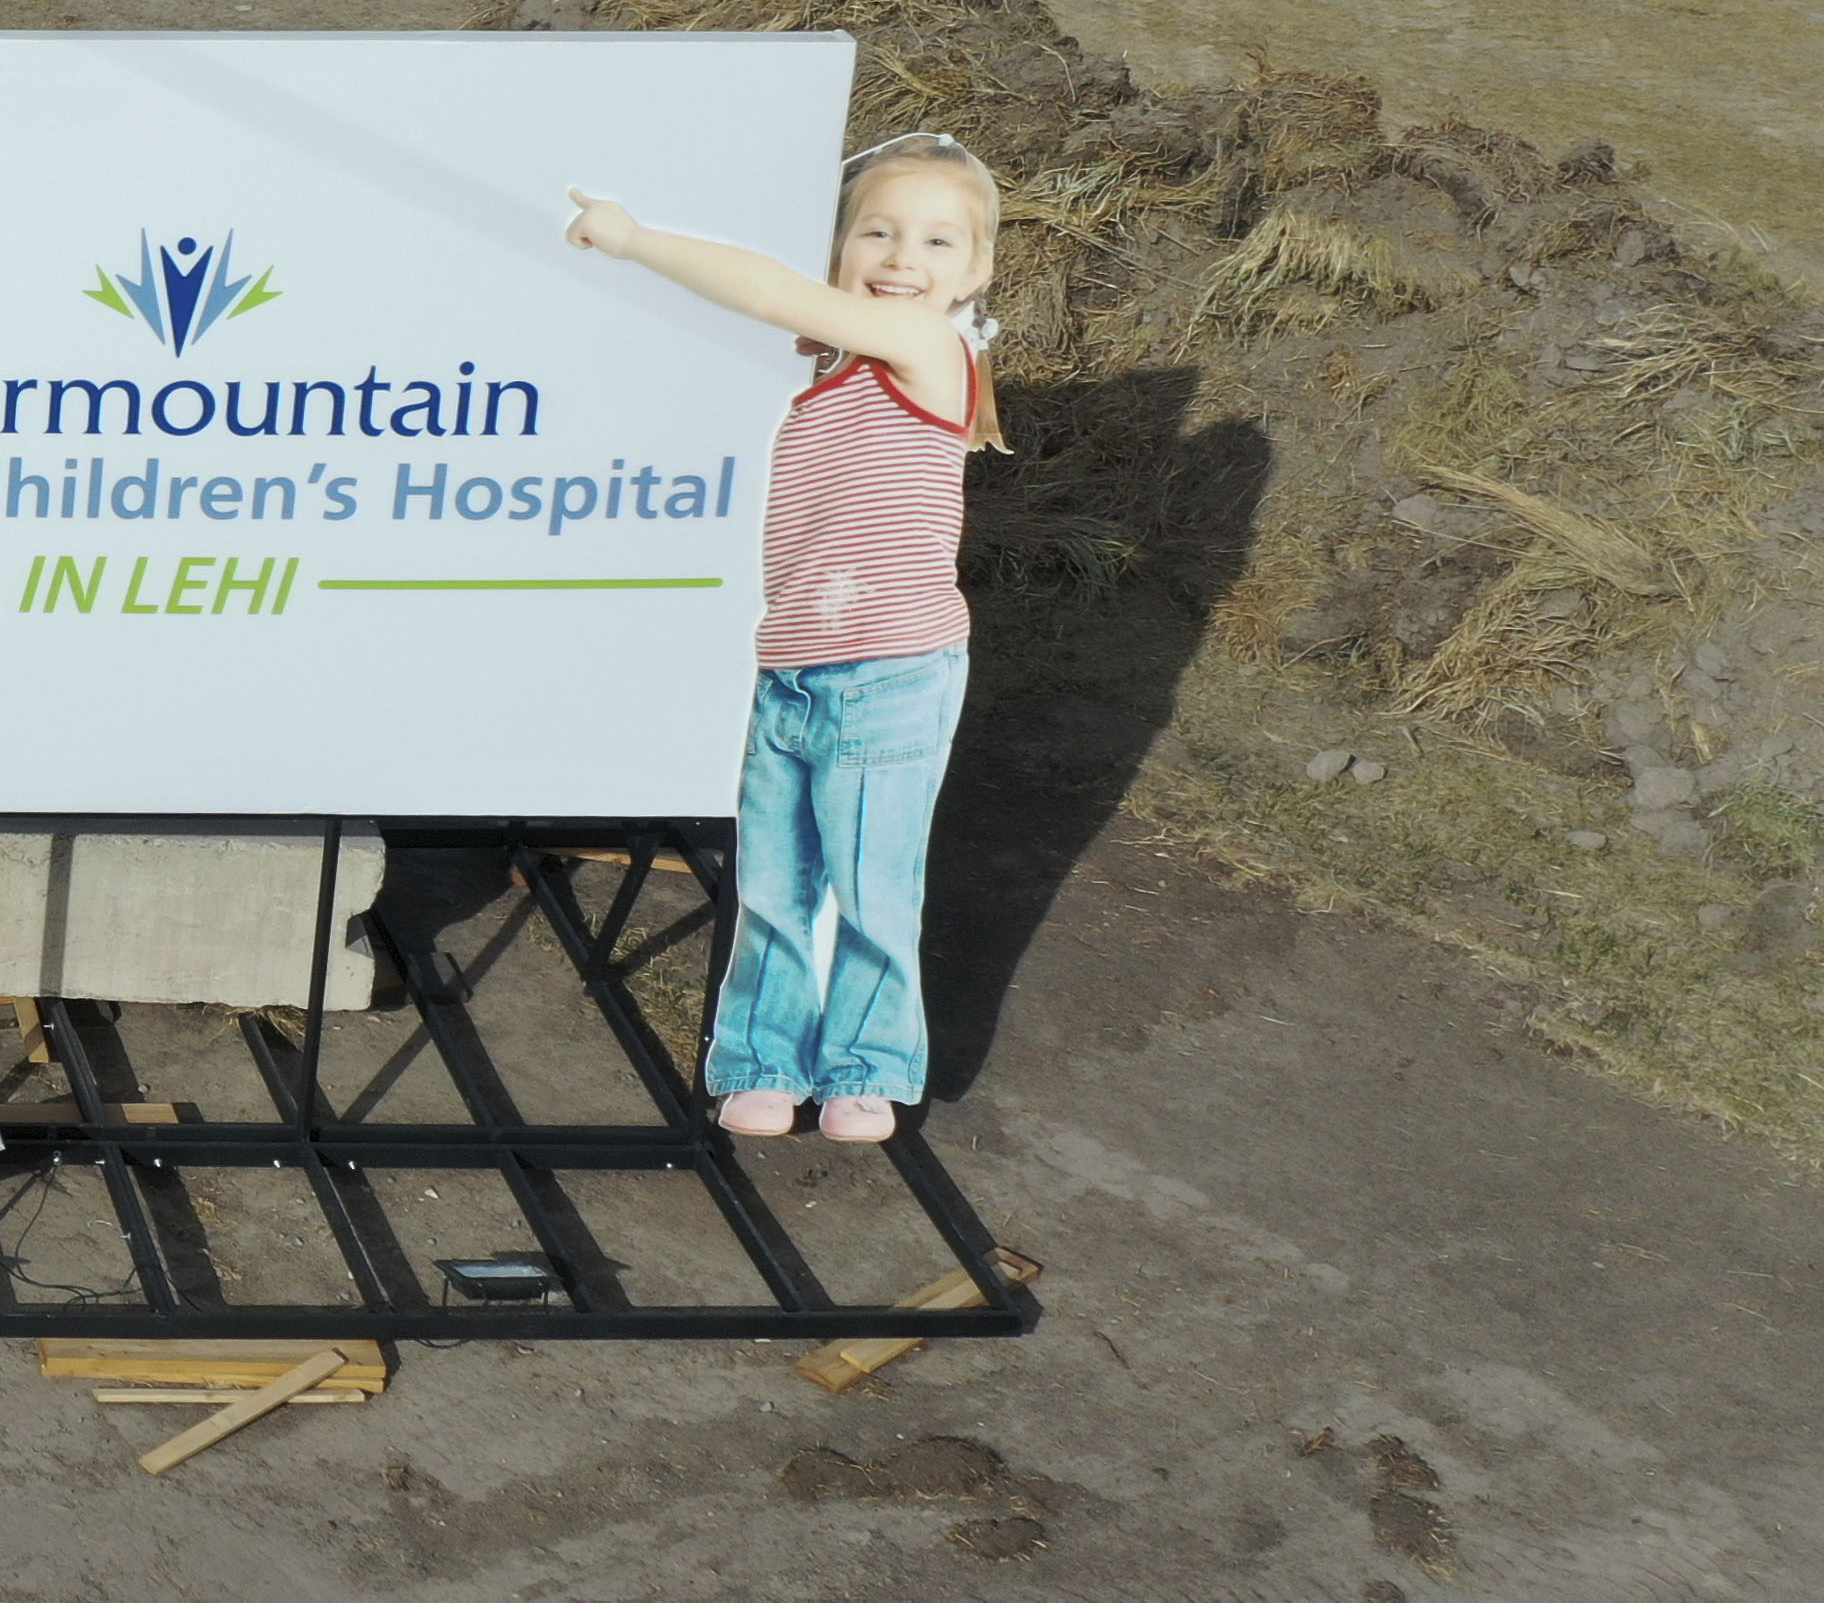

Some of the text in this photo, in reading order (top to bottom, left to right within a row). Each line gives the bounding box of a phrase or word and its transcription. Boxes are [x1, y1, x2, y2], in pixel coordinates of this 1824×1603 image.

[394, 457, 738, 536] Hospital
[19, 555, 301, 616] IN LEHI
